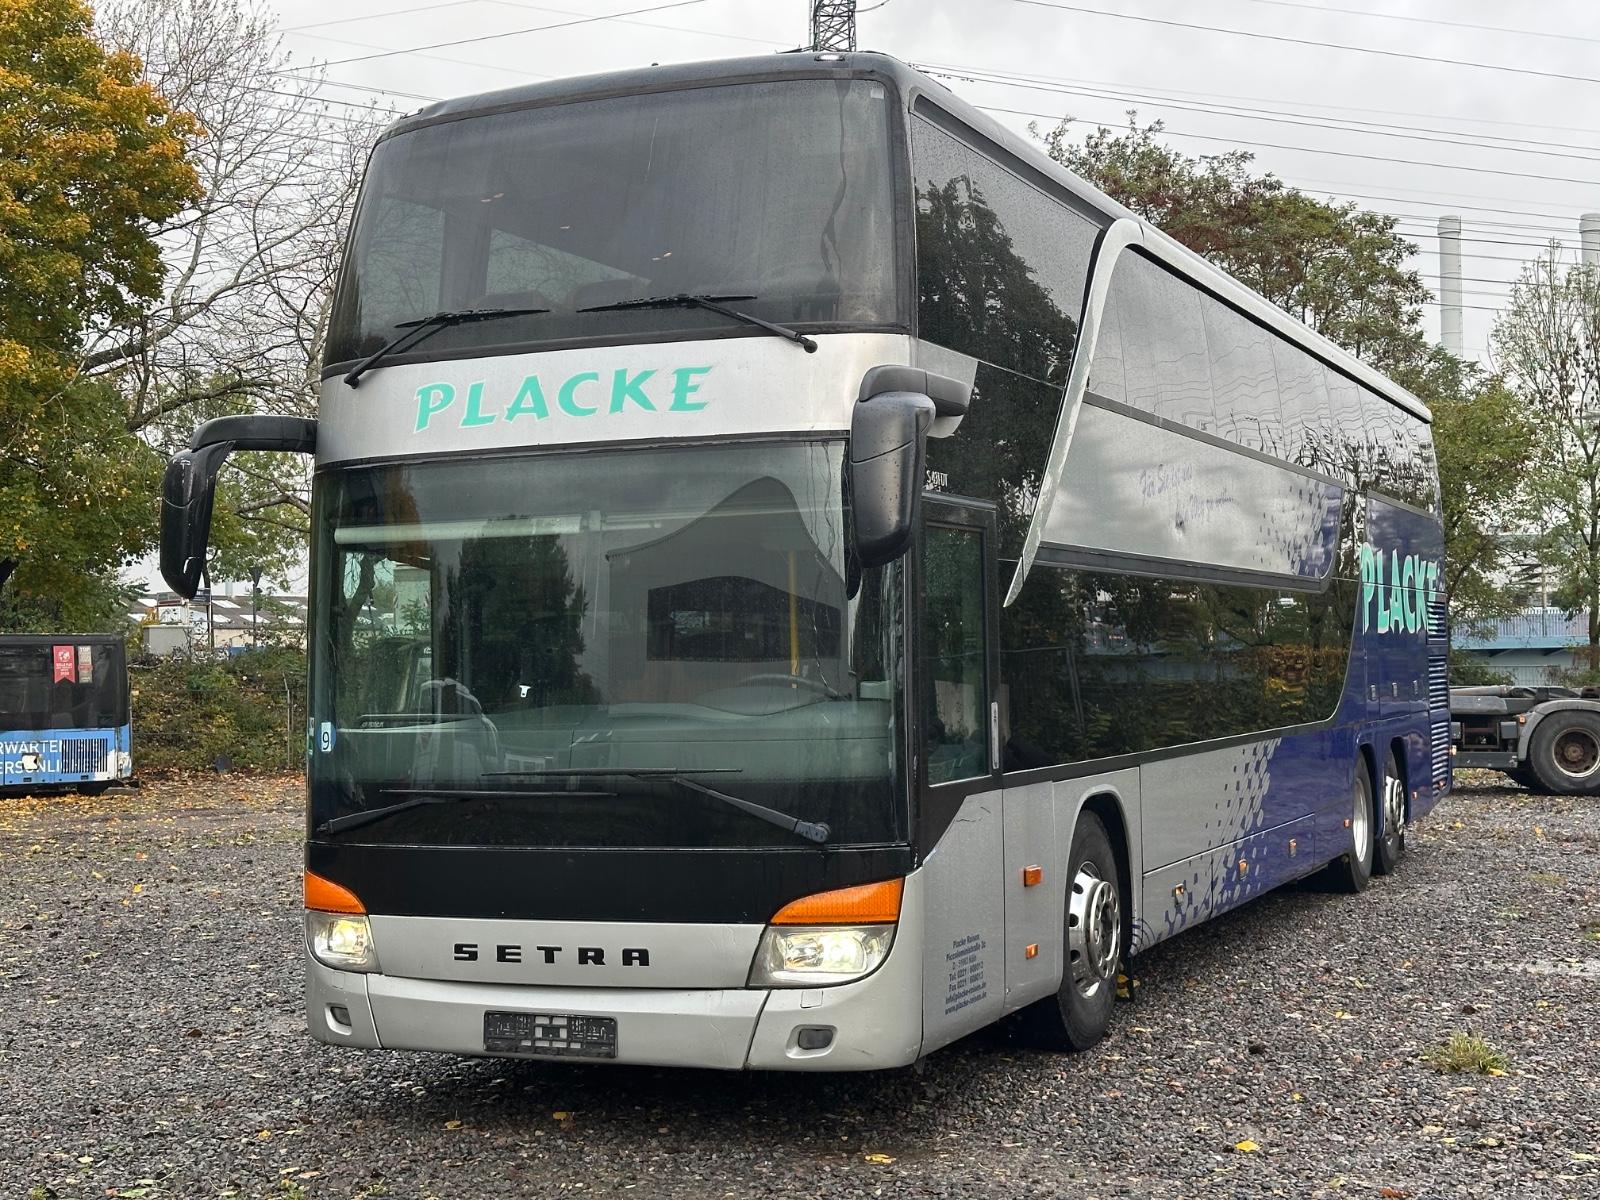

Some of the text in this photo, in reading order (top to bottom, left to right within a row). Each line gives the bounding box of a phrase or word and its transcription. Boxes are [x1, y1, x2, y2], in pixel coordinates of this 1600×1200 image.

[413, 365, 713, 434] PLACKE
[322, 731, 330, 751] 9
[453, 943, 650, 967] SETRA
